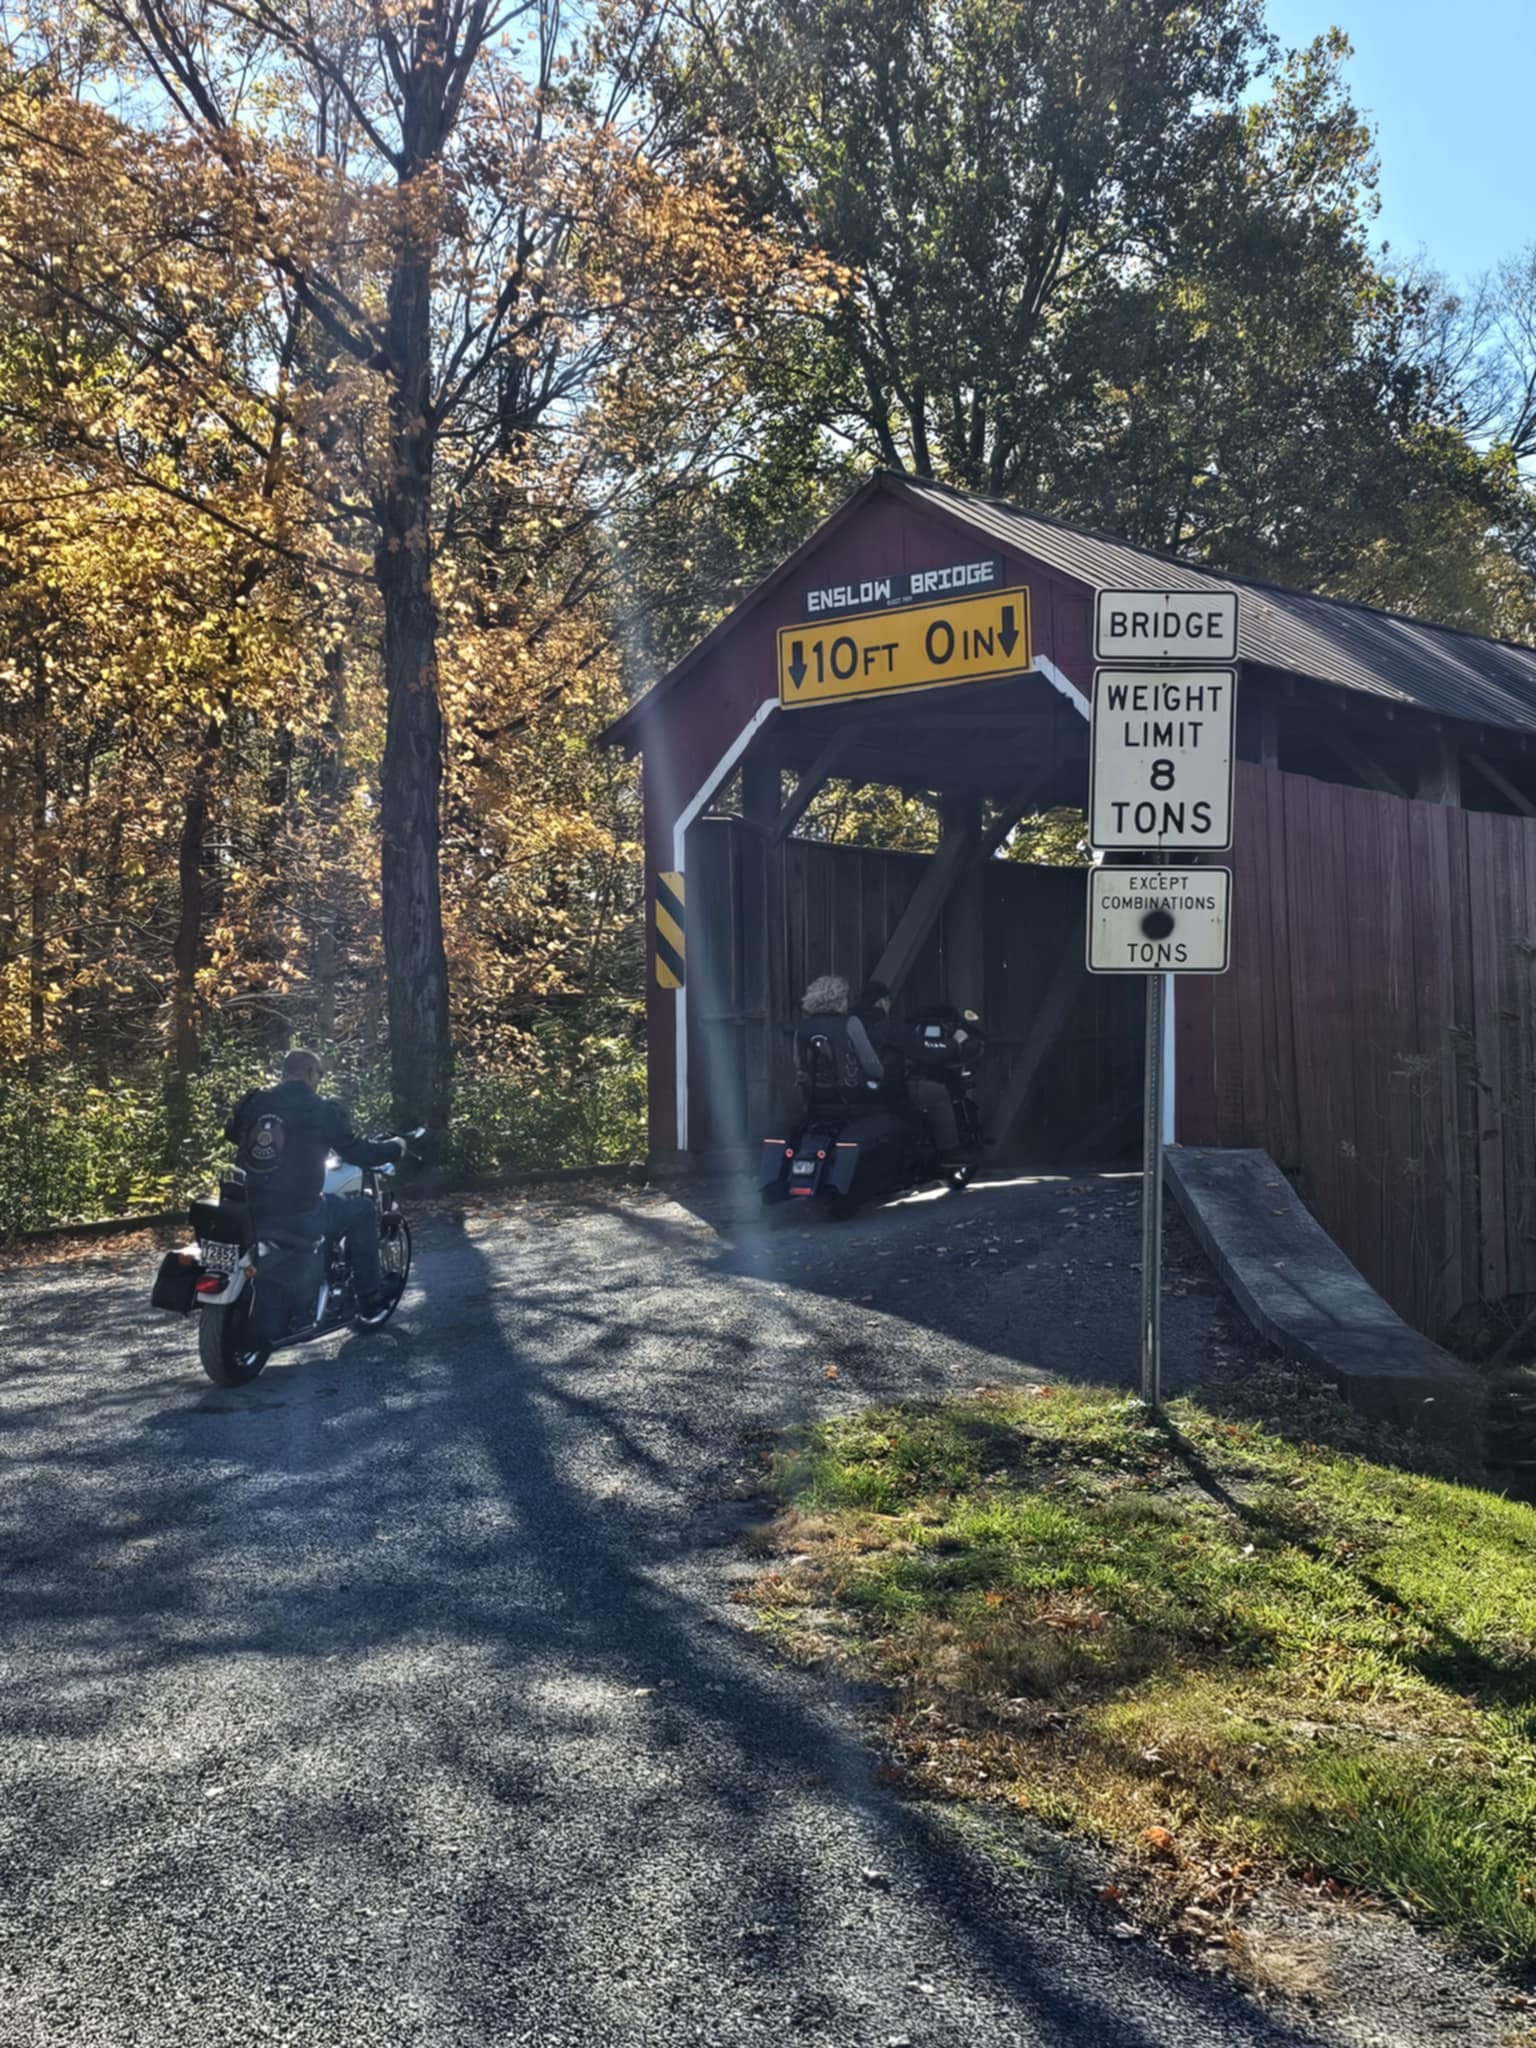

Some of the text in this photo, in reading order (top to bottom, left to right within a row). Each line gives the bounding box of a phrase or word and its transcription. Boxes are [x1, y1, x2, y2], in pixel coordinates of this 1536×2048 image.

[807, 561, 994, 612] ENSLOW BRIDGE
[1110, 612, 1223, 638] BRIDGE
[1108, 685, 1223, 711] WEIGHT
[1125, 722, 1203, 748] LIMIT
[1150, 759, 1175, 791] 8
[1111, 801, 1212, 834] TONS
[1129, 876, 1189, 890] EXCEPT
[1102, 896, 1215, 910] COMBINATIONS
[1128, 943, 1188, 962] TONS
